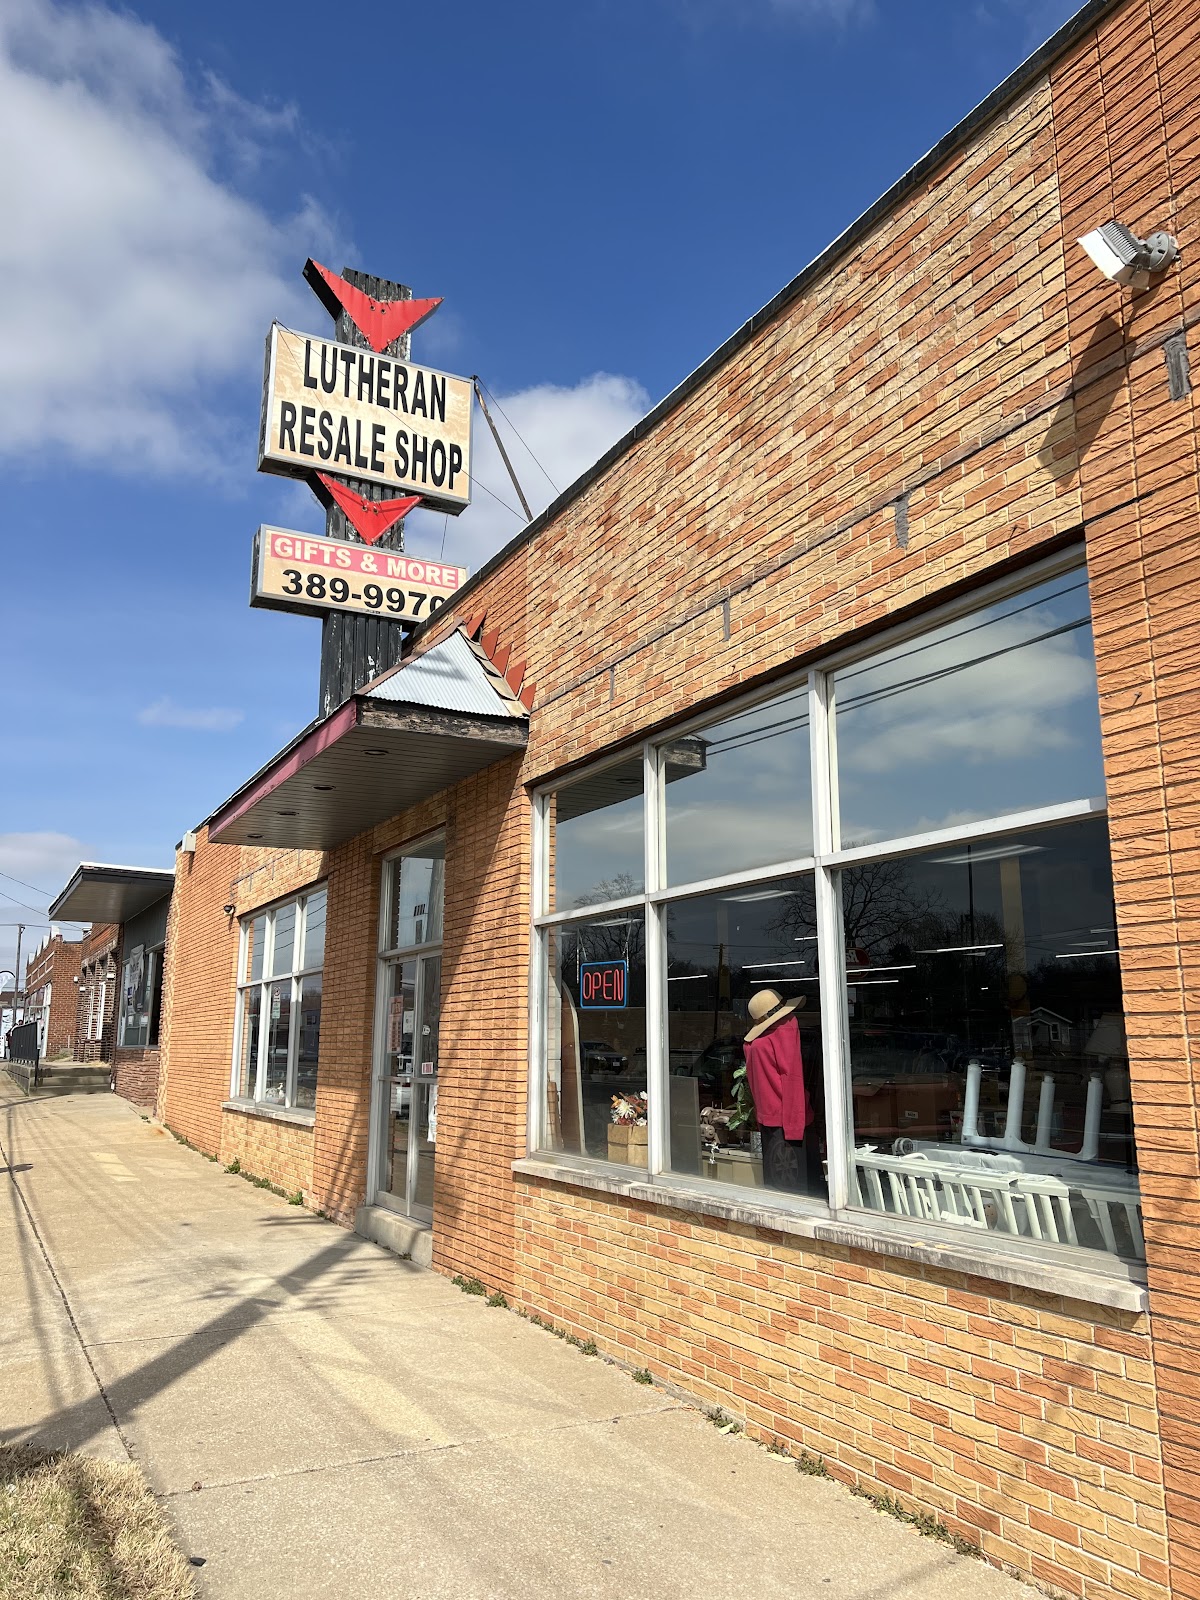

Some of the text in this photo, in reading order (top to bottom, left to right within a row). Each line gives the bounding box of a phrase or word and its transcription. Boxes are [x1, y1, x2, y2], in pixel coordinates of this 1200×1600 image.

[303, 339, 446, 423] LUTHERAN
[279, 400, 463, 490] RESALE SHOP
[274, 537, 456, 589] GIFTS & MORE
[583, 969, 624, 1002] OPEN
